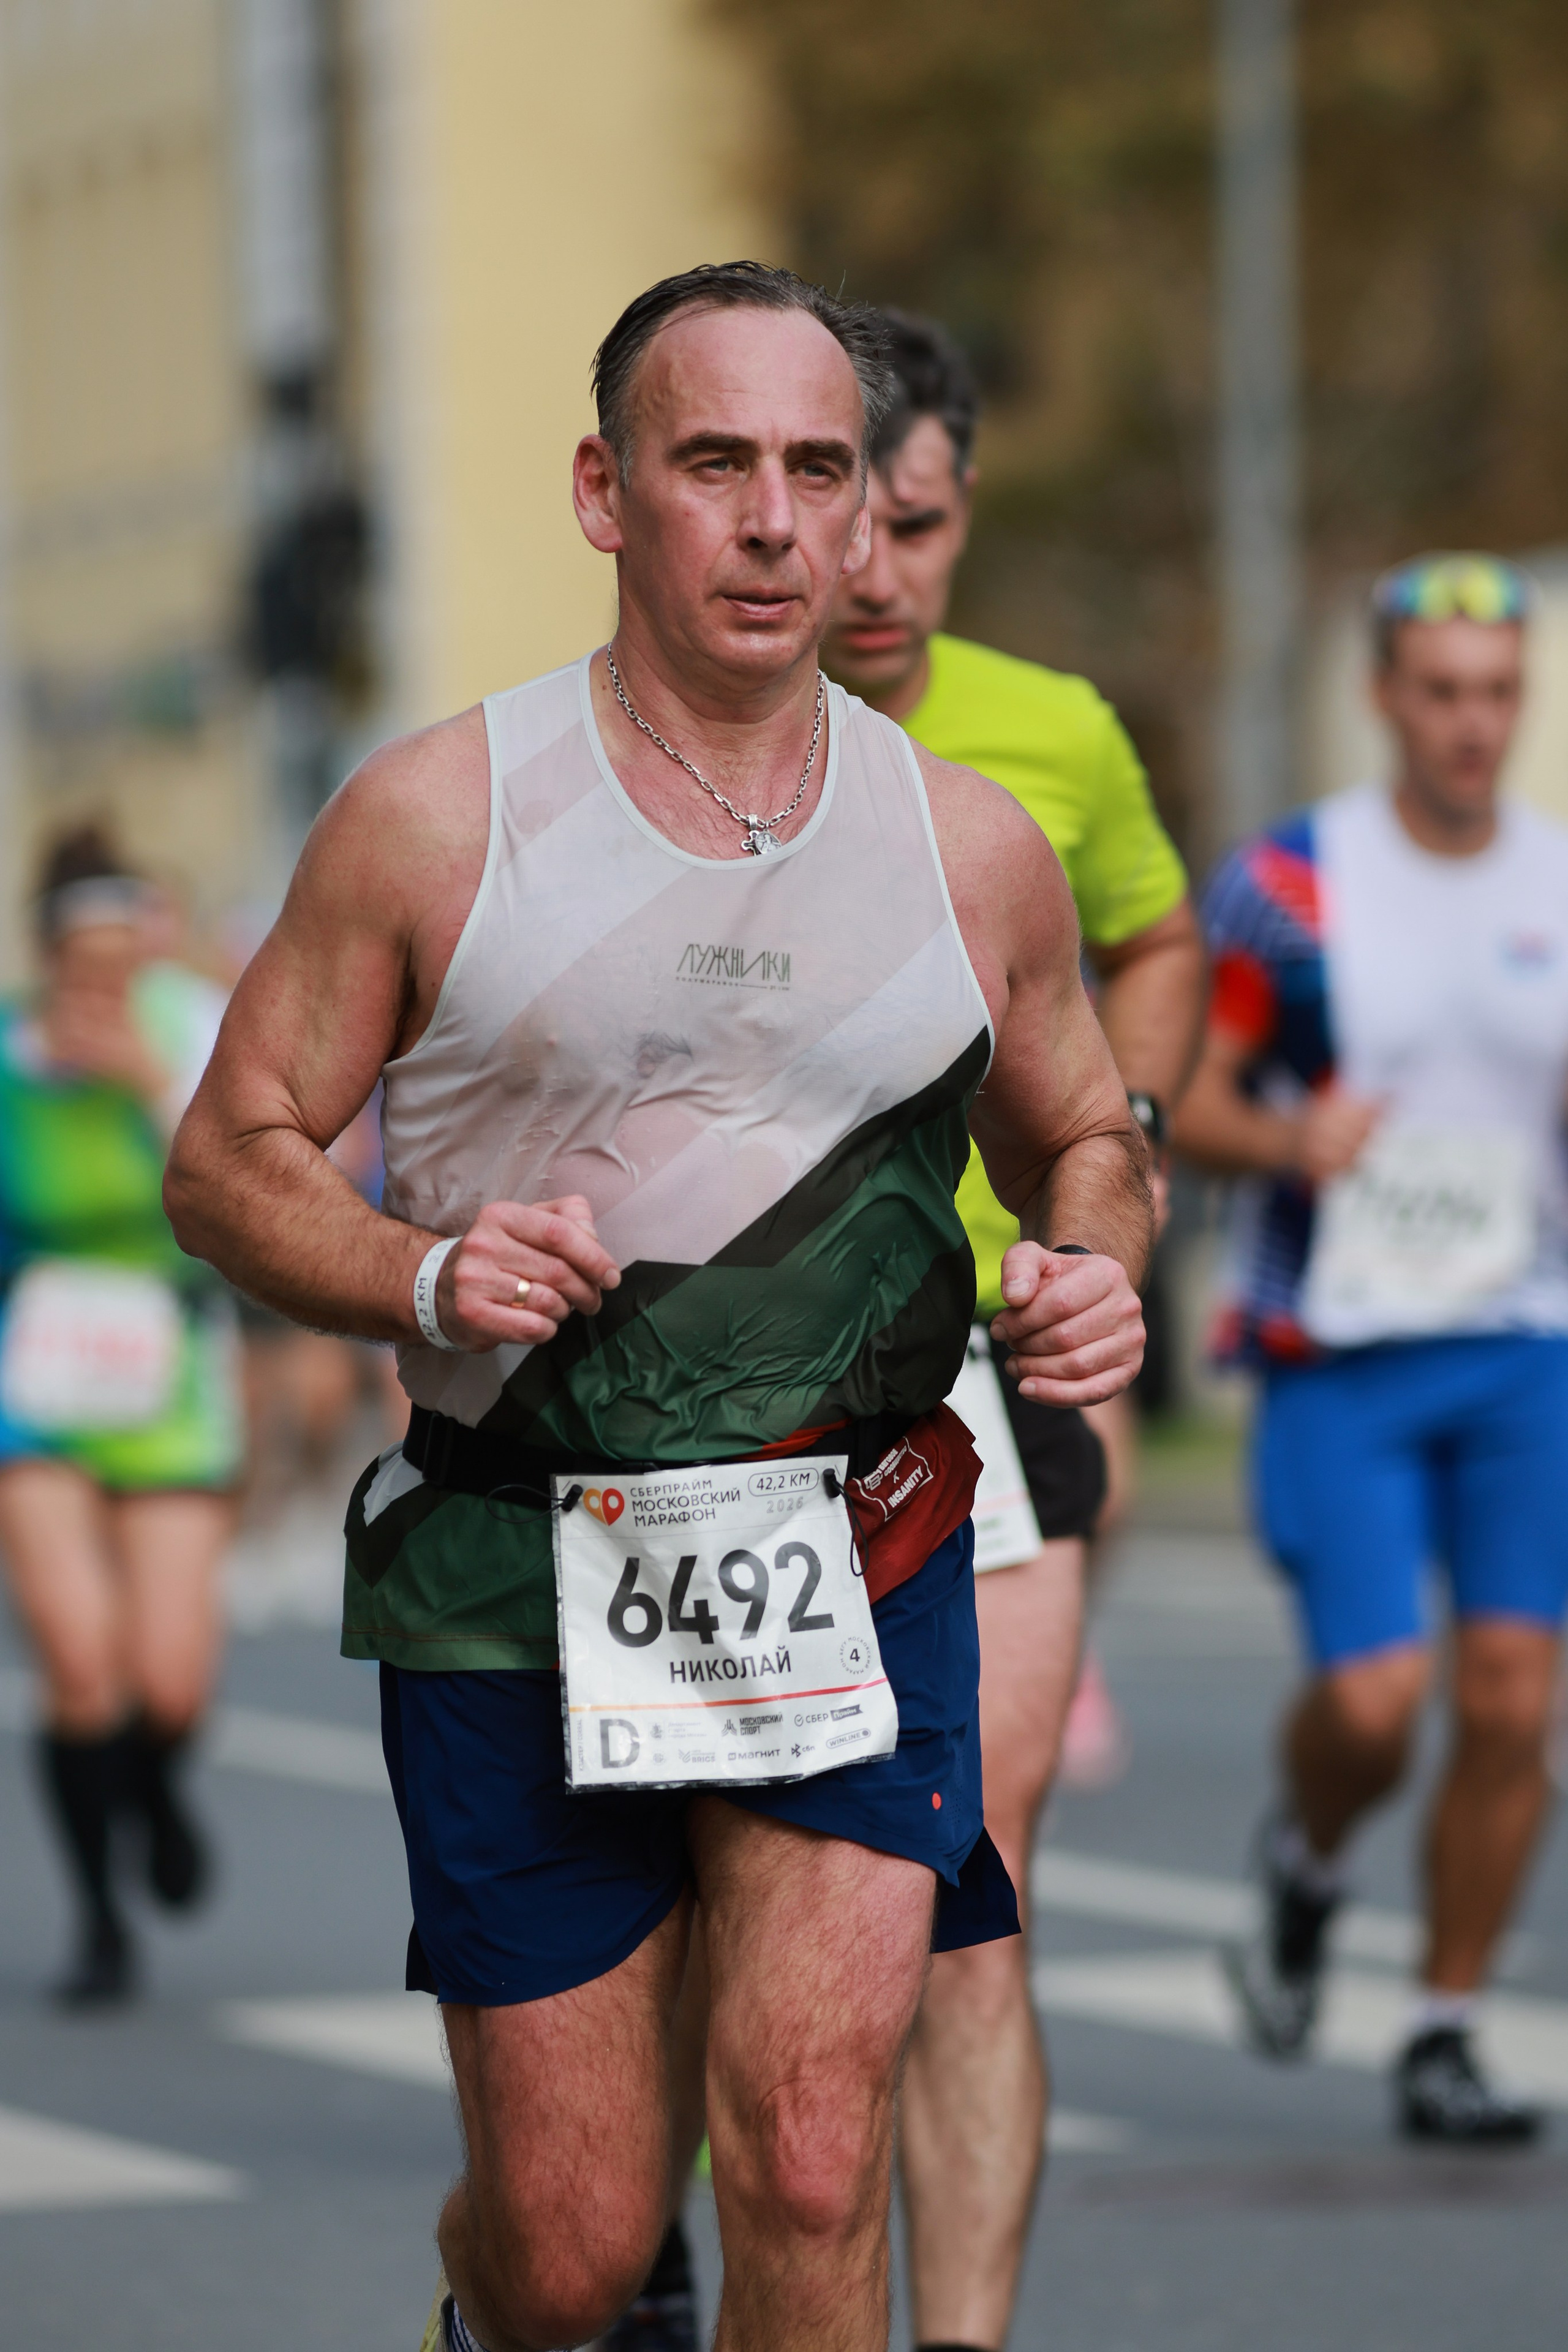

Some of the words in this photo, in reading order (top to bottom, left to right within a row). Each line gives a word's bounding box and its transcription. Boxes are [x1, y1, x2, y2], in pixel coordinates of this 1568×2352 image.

[677, 944, 790, 982] ЛУЖНИКИ
[630, 1479, 712, 1498] СБЕРПРАЙМ
[756, 1476, 785, 1491] 42,2
[888, 1465, 924, 1508] INSANITY
[631, 1487, 741, 1512] МОСКОВСКИЙ
[634, 1508, 716, 1527] МАРАФОН
[607, 1541, 834, 1648] 6492
[670, 1645, 791, 1683] НИКОЛАЙ
[850, 1648, 861, 1662] 4
[739, 1713, 783, 1726] МОСКОВСКИЙ
[805, 1713, 828, 1724] СБЕР
[740, 1726, 761, 1736] СПОРТ
[829, 1732, 861, 1746] WINLINE
[600, 1719, 640, 1769] D
